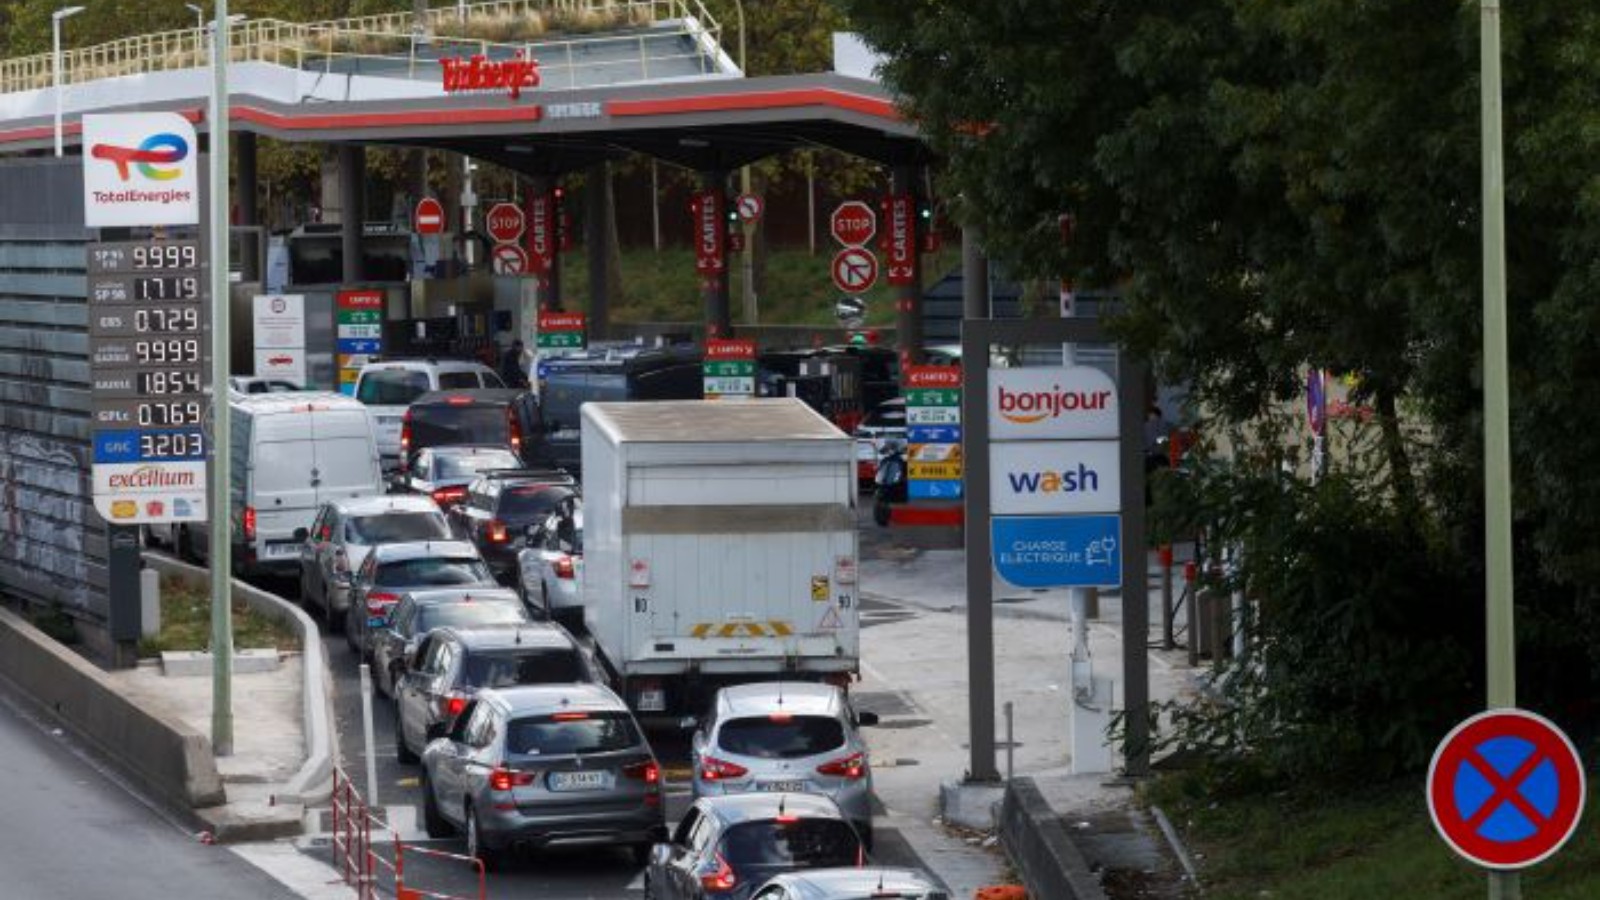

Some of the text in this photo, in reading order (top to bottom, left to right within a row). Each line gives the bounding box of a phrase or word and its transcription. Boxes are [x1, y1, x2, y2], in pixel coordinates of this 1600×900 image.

[92, 189, 191, 204] TotalEnergies
[491, 216, 521, 231] STOP
[534, 198, 546, 254] CARTES
[703, 196, 716, 252] CARTES
[836, 217, 871, 232] STOP
[893, 199, 908, 261] CARTES
[143, 278, 197, 300] 1.719
[998, 384, 1111, 418] bonjour
[108, 468, 195, 488] excellium
[1007, 462, 1099, 493] wash
[1012, 540, 1068, 552] CHARGE
[1000, 552, 1081, 564] ELECTRIQUE
